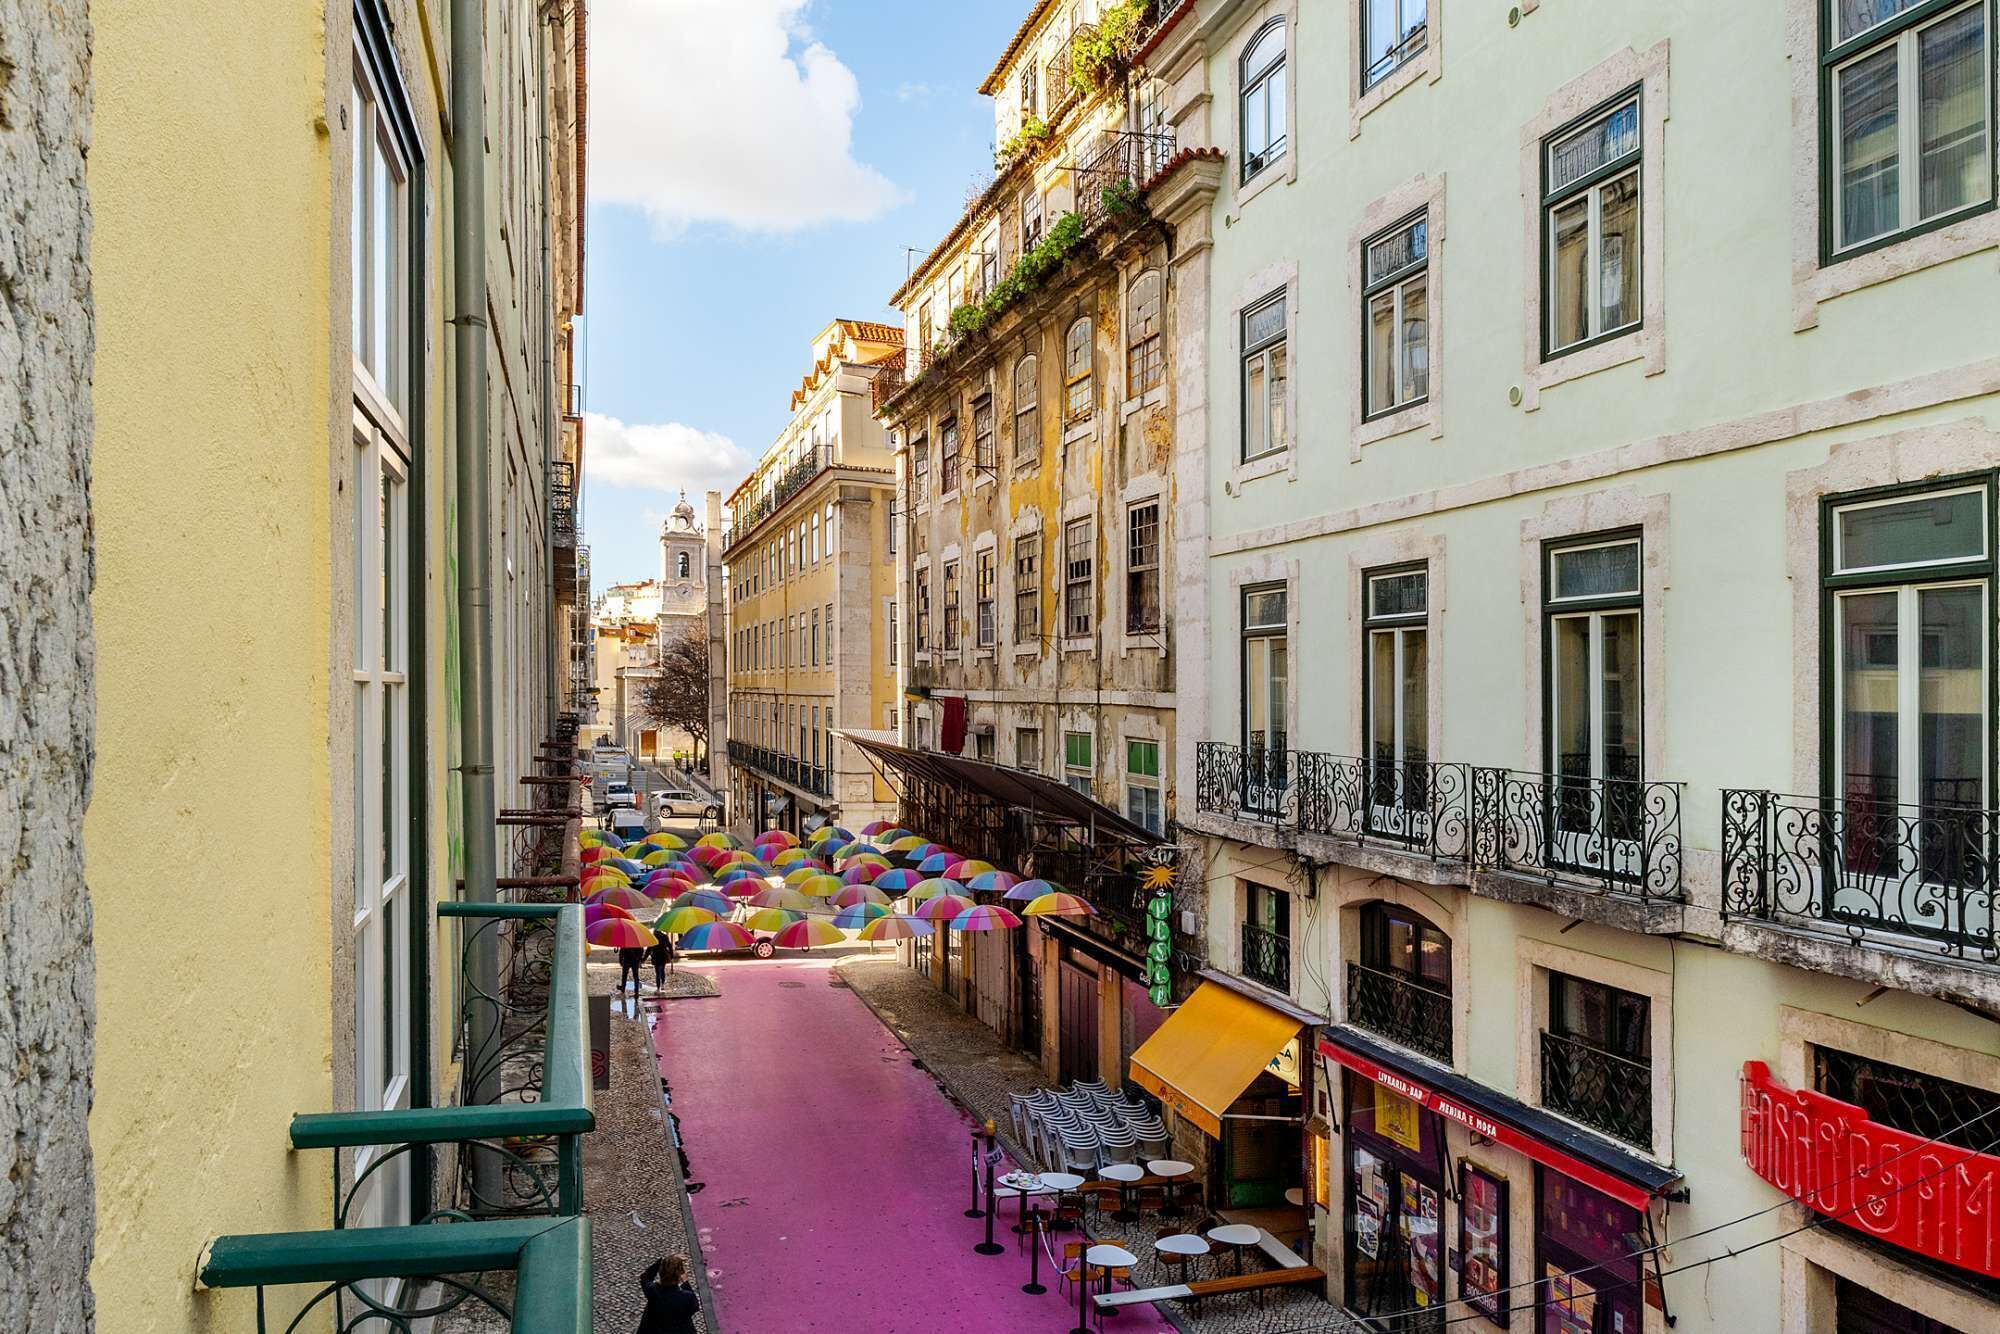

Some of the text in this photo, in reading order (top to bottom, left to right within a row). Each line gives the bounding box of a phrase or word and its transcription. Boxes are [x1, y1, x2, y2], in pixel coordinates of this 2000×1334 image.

[1438, 1101, 1497, 1137] MENINA E MOÇA
